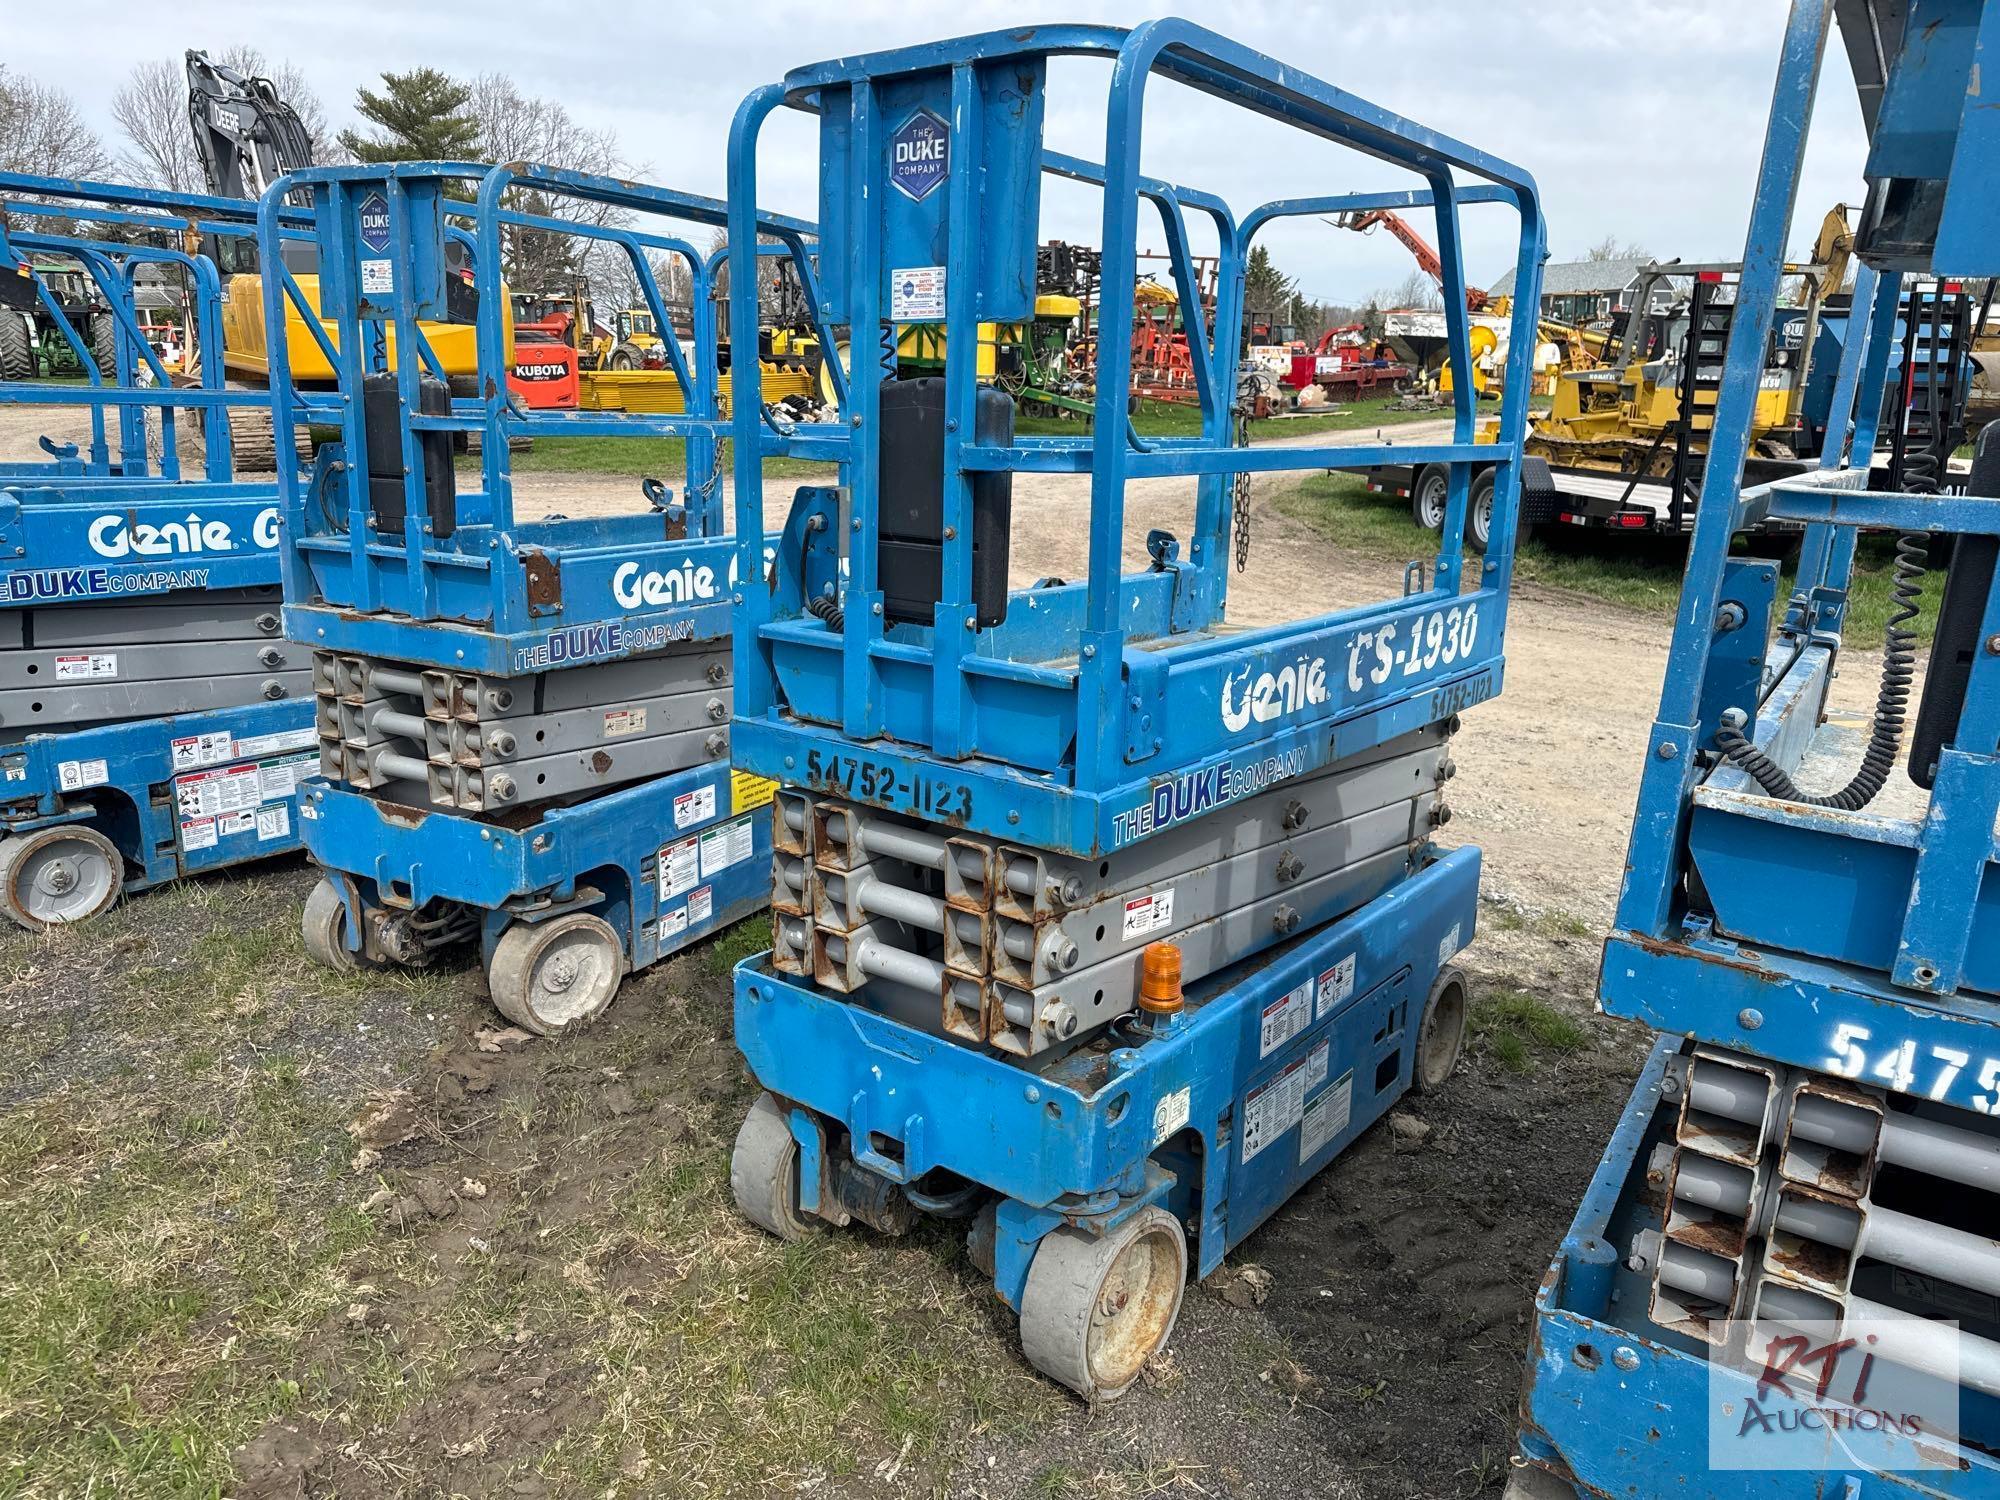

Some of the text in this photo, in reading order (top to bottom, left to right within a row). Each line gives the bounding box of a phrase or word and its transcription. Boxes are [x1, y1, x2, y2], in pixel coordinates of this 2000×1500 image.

[214, 103, 240, 133] DEERE
[913, 128, 929, 138] THE
[896, 139, 945, 163] DUKE
[899, 163, 941, 176] COMPANY
[362, 214, 390, 229] DUKE
[516, 364, 565, 377] KUBOTA
[88, 512, 233, 558] Genie
[8, 568, 108, 601] DUKE
[108, 568, 210, 593] COMPANY
[613, 557, 715, 609] Genie
[514, 619, 695, 671] THE DUKE COMPANY
[1431, 675, 1492, 720] 54752-1123
[807, 749, 972, 822] 54752-1123
[1112, 744, 1308, 846] THE DUKE COMPANY
